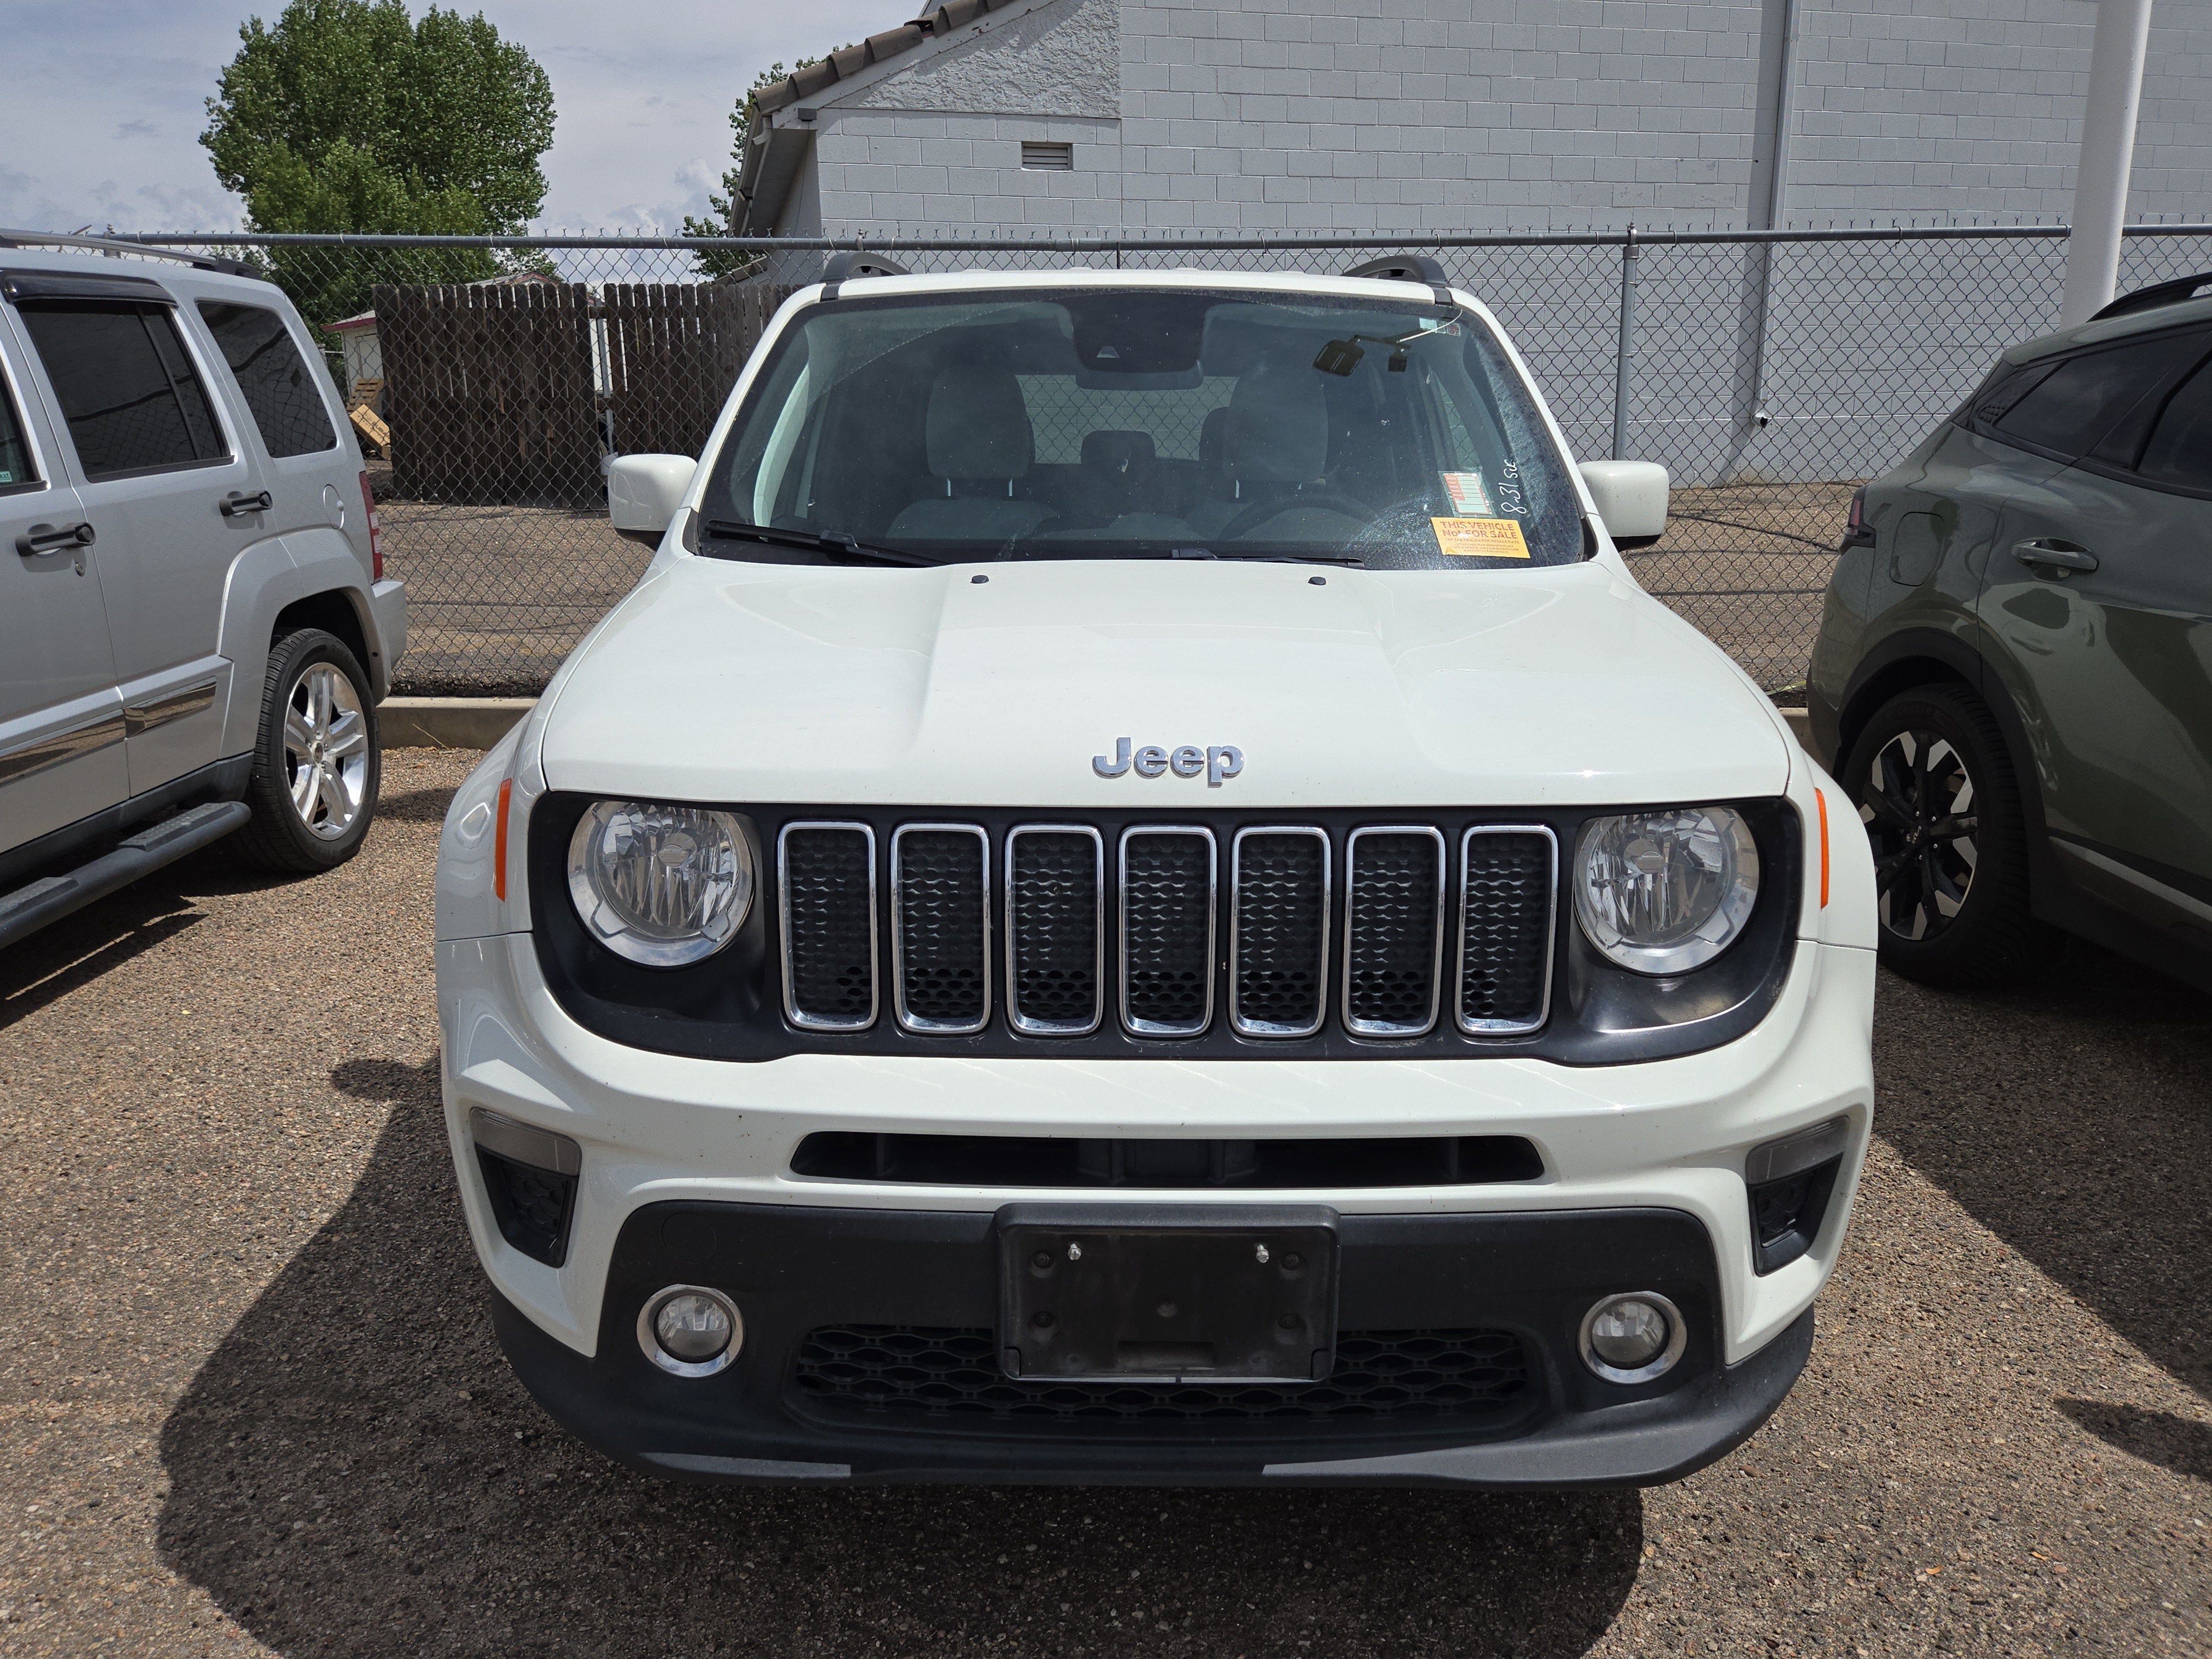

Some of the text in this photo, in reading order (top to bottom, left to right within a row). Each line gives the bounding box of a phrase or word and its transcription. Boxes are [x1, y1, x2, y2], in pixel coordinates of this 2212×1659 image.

[1468, 522, 1515, 531] VEHICLE
[1465, 530, 1488, 538] FOR
[1490, 531, 1517, 539] SALE
[1092, 737, 1244, 788] Jeep
